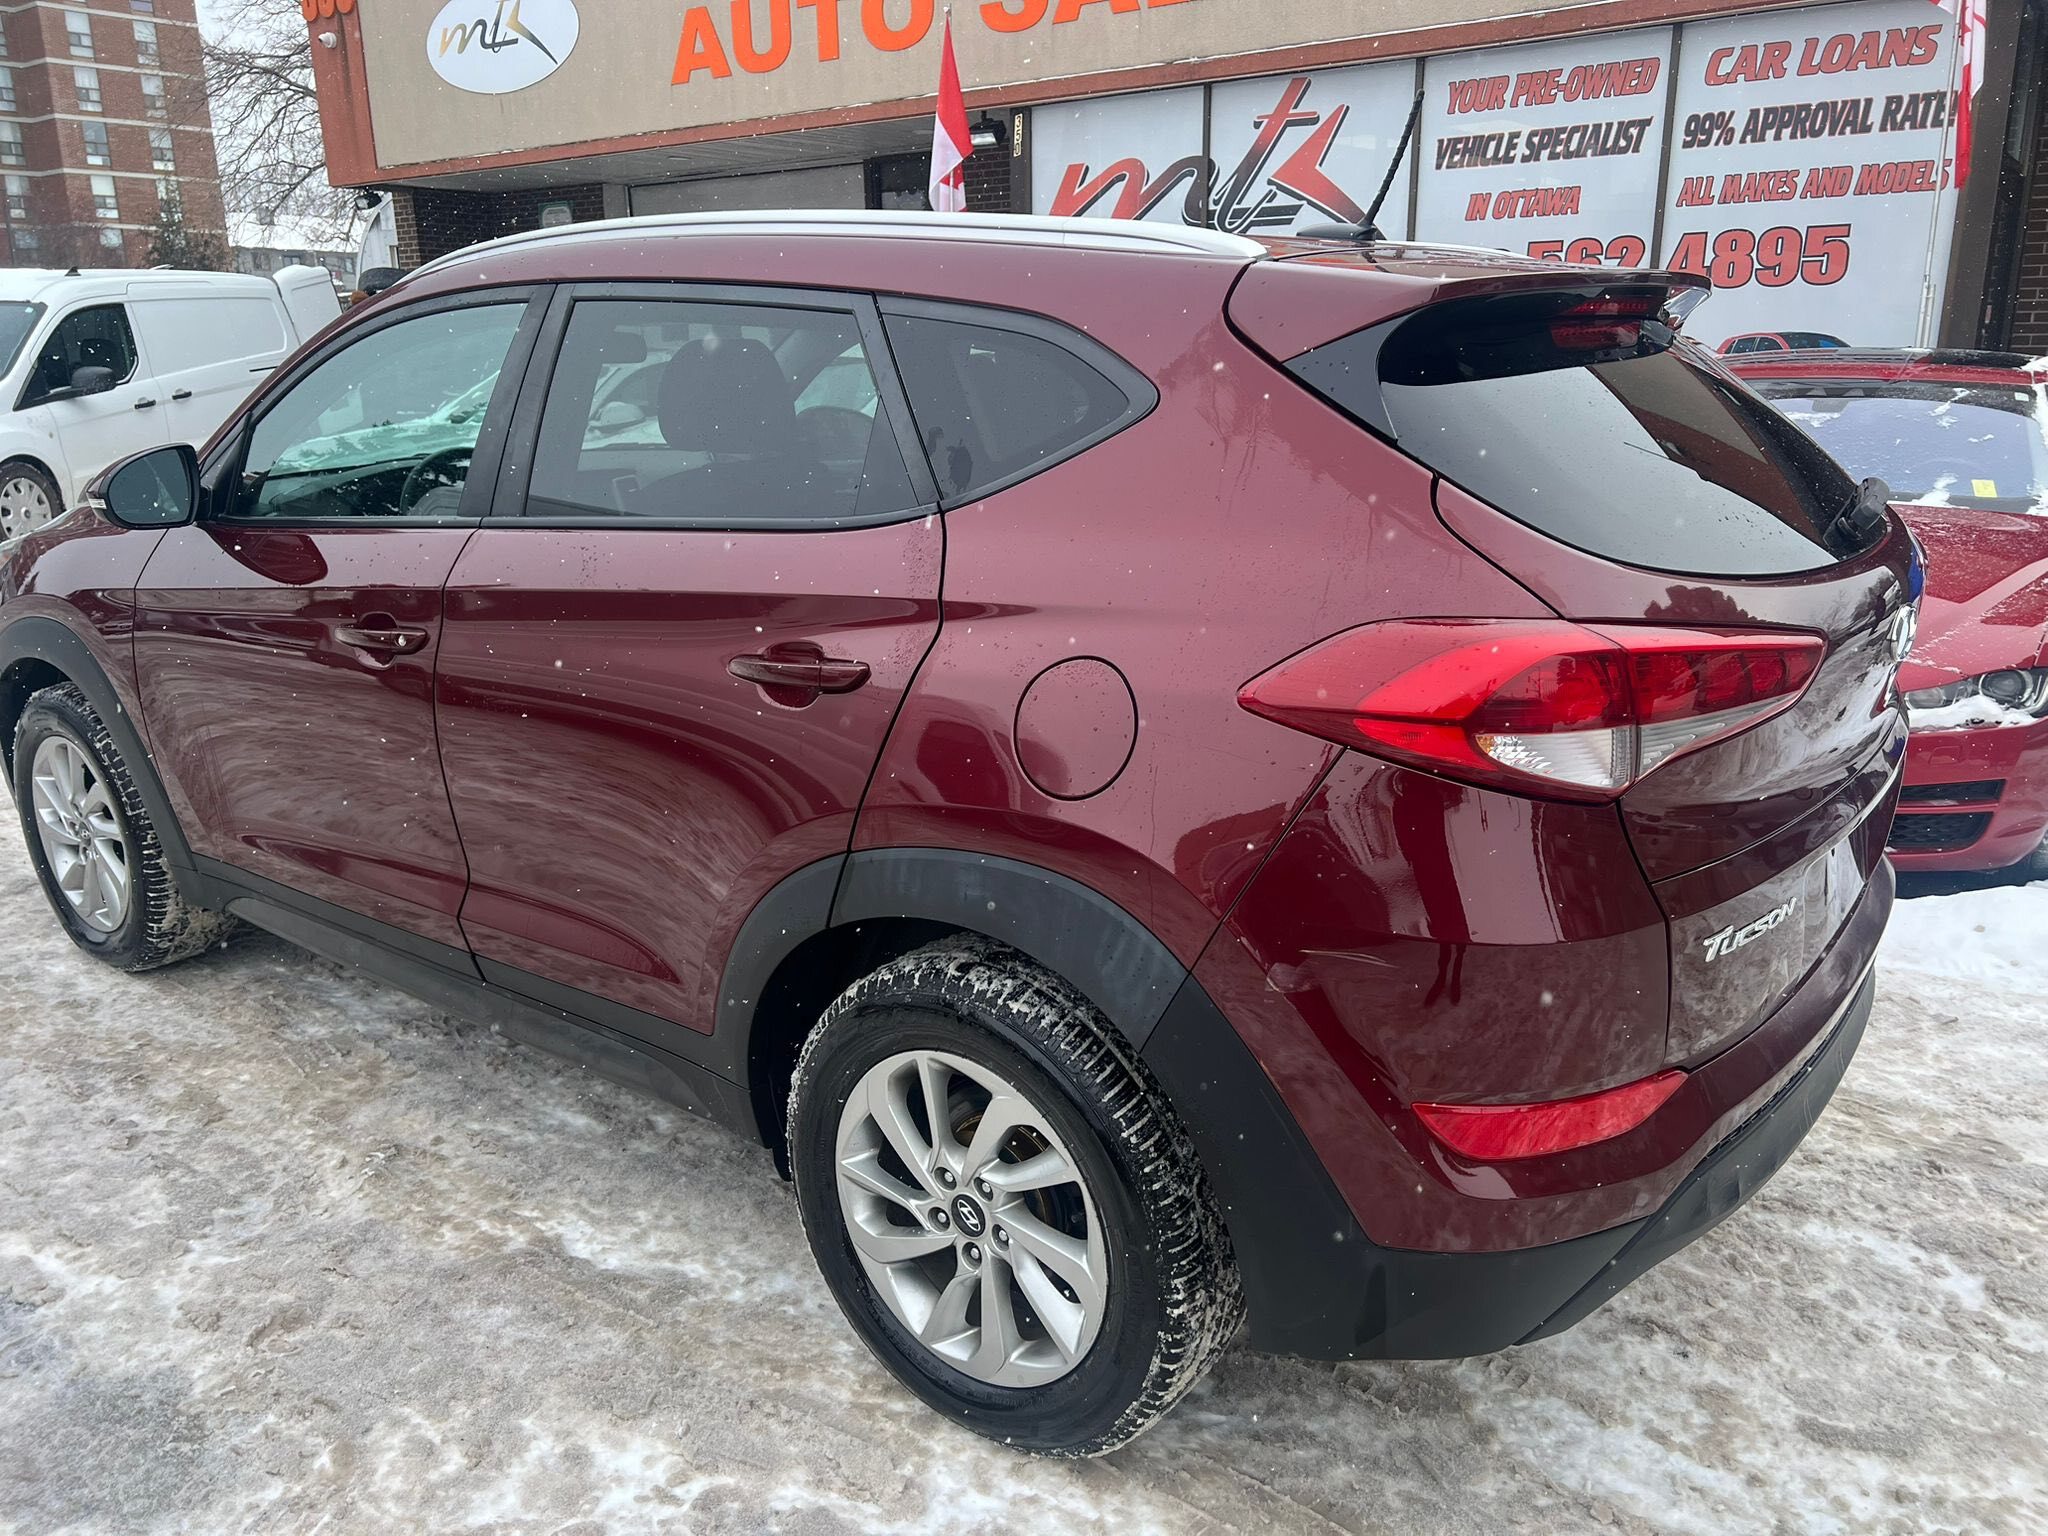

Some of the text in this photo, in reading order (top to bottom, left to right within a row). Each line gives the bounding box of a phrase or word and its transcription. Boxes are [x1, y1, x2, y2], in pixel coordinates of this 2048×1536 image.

[671, 0, 934, 86] AUTO
[1704, 24, 1943, 86] CAR LOANS
[1447, 57, 1660, 114] YOUR PRE-OWNED
[1435, 116, 1654, 170] VEHICLE SPECIALIST
[1681, 110, 1736, 149] 99%
[1739, 97, 1874, 145] APPROVAL
[1465, 186, 1582, 221] IN OTTAWA
[1676, 158, 1953, 207] ALL MAKES AND MODELS
[1666, 224, 1852, 289] 4895
[1703, 897, 1796, 962] TUCSON
